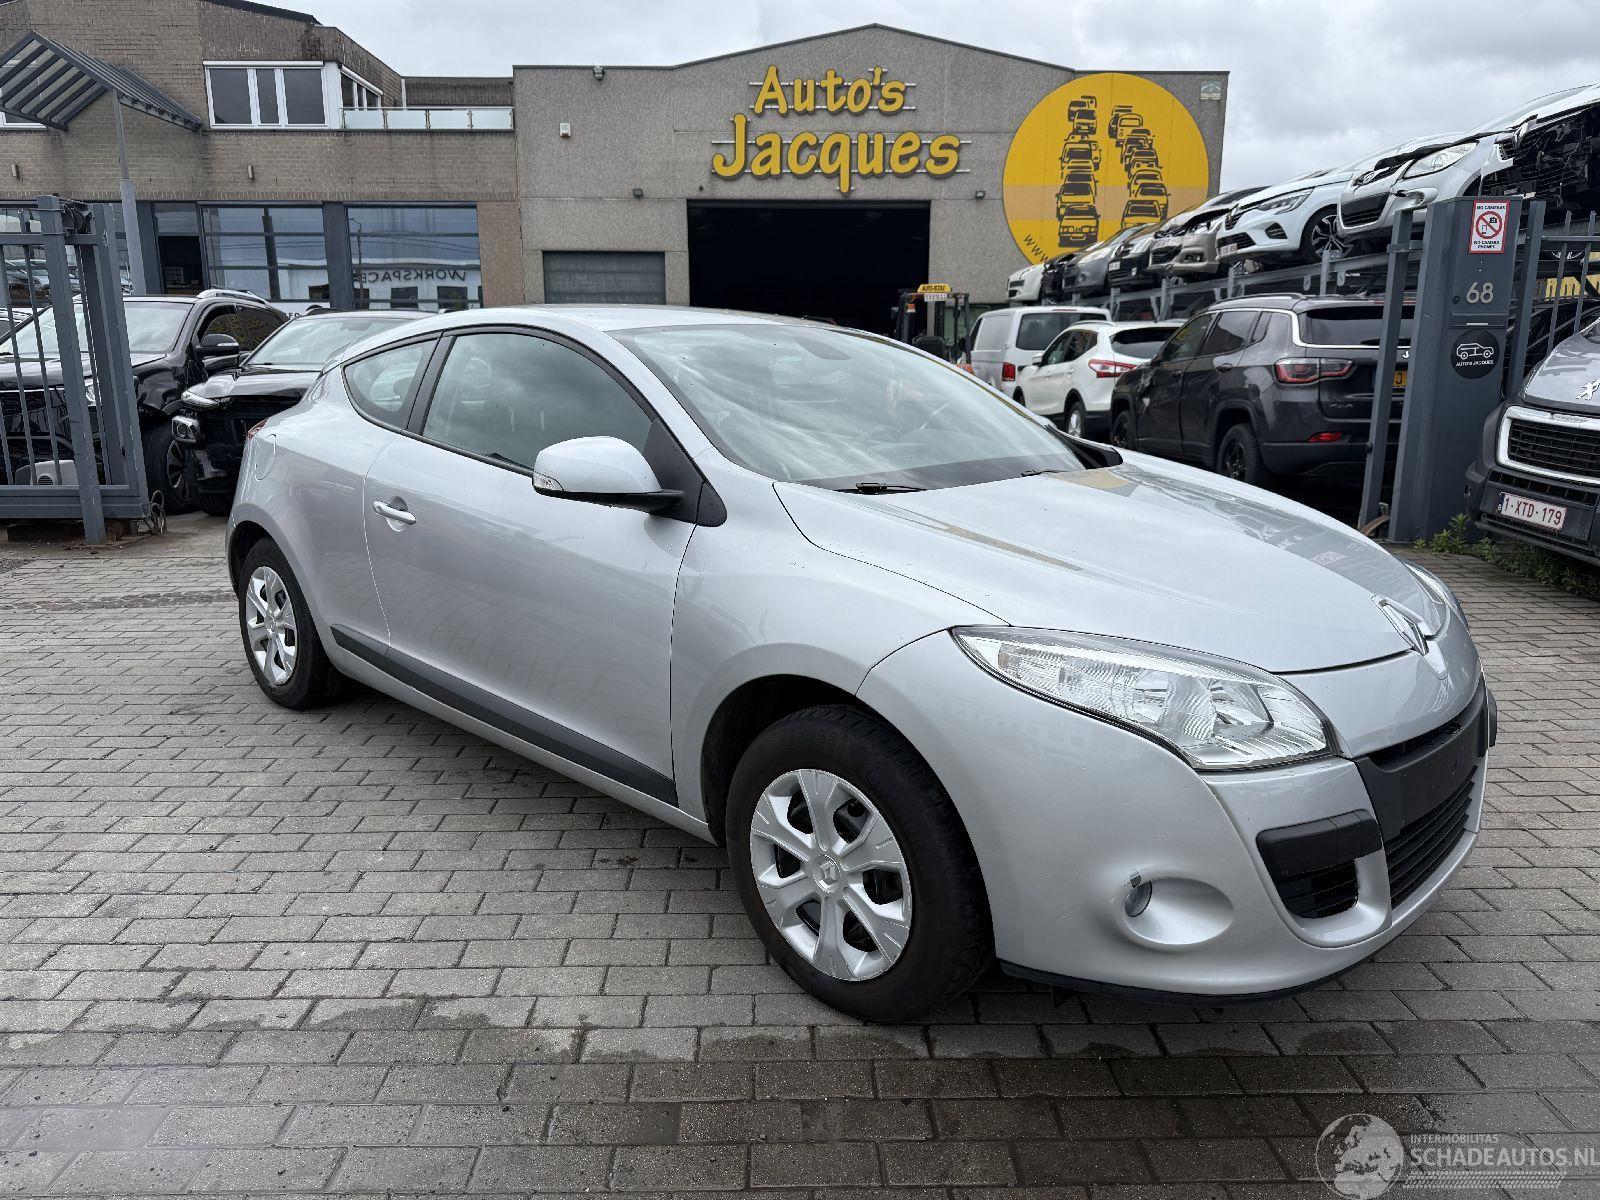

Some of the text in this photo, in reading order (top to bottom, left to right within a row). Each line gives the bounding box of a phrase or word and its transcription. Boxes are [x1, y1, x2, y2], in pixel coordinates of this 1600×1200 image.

[753, 65, 906, 115] Auto's
[712, 113, 961, 194] Jacques
[1466, 282, 1494, 304] 68
